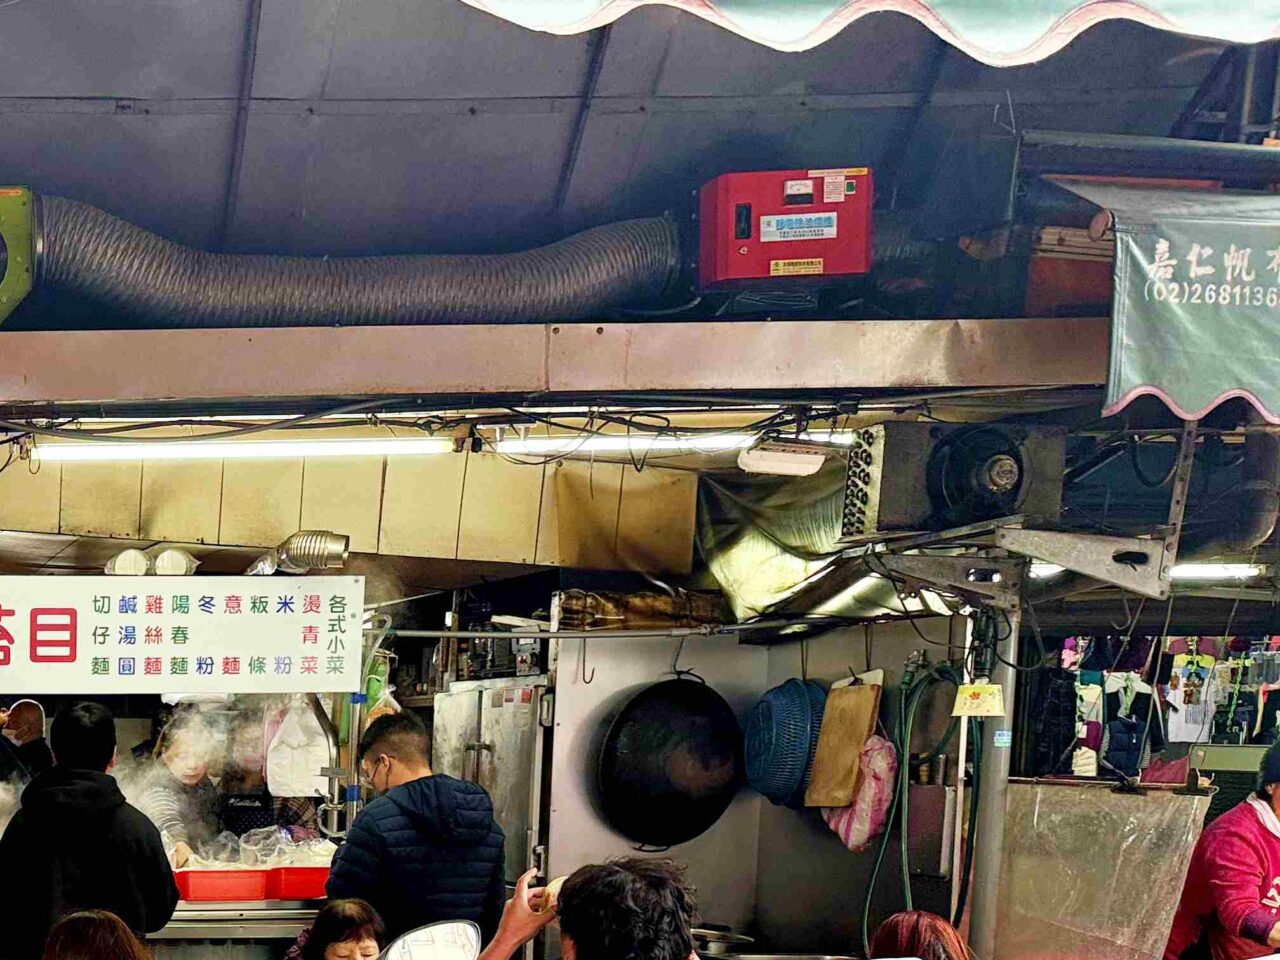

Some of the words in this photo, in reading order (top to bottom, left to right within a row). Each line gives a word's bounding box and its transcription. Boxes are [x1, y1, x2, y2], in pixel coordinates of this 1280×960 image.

[1144, 280, 1280, 308] (02)2681136
[91, 595, 110, 675] 切仔麵
[118, 595, 137, 675] 鹹湯圓
[144, 595, 164, 675] 雞絲麵
[170, 595, 189, 675] 陽春麵
[196, 595, 216, 675] 冬粉
[222, 595, 242, 675] 意麵
[248, 595, 269, 675] 粄條
[274, 595, 294, 675] 米粉
[300, 595, 321, 675] 燙青菜
[326, 595, 347, 675] 各式小菜
